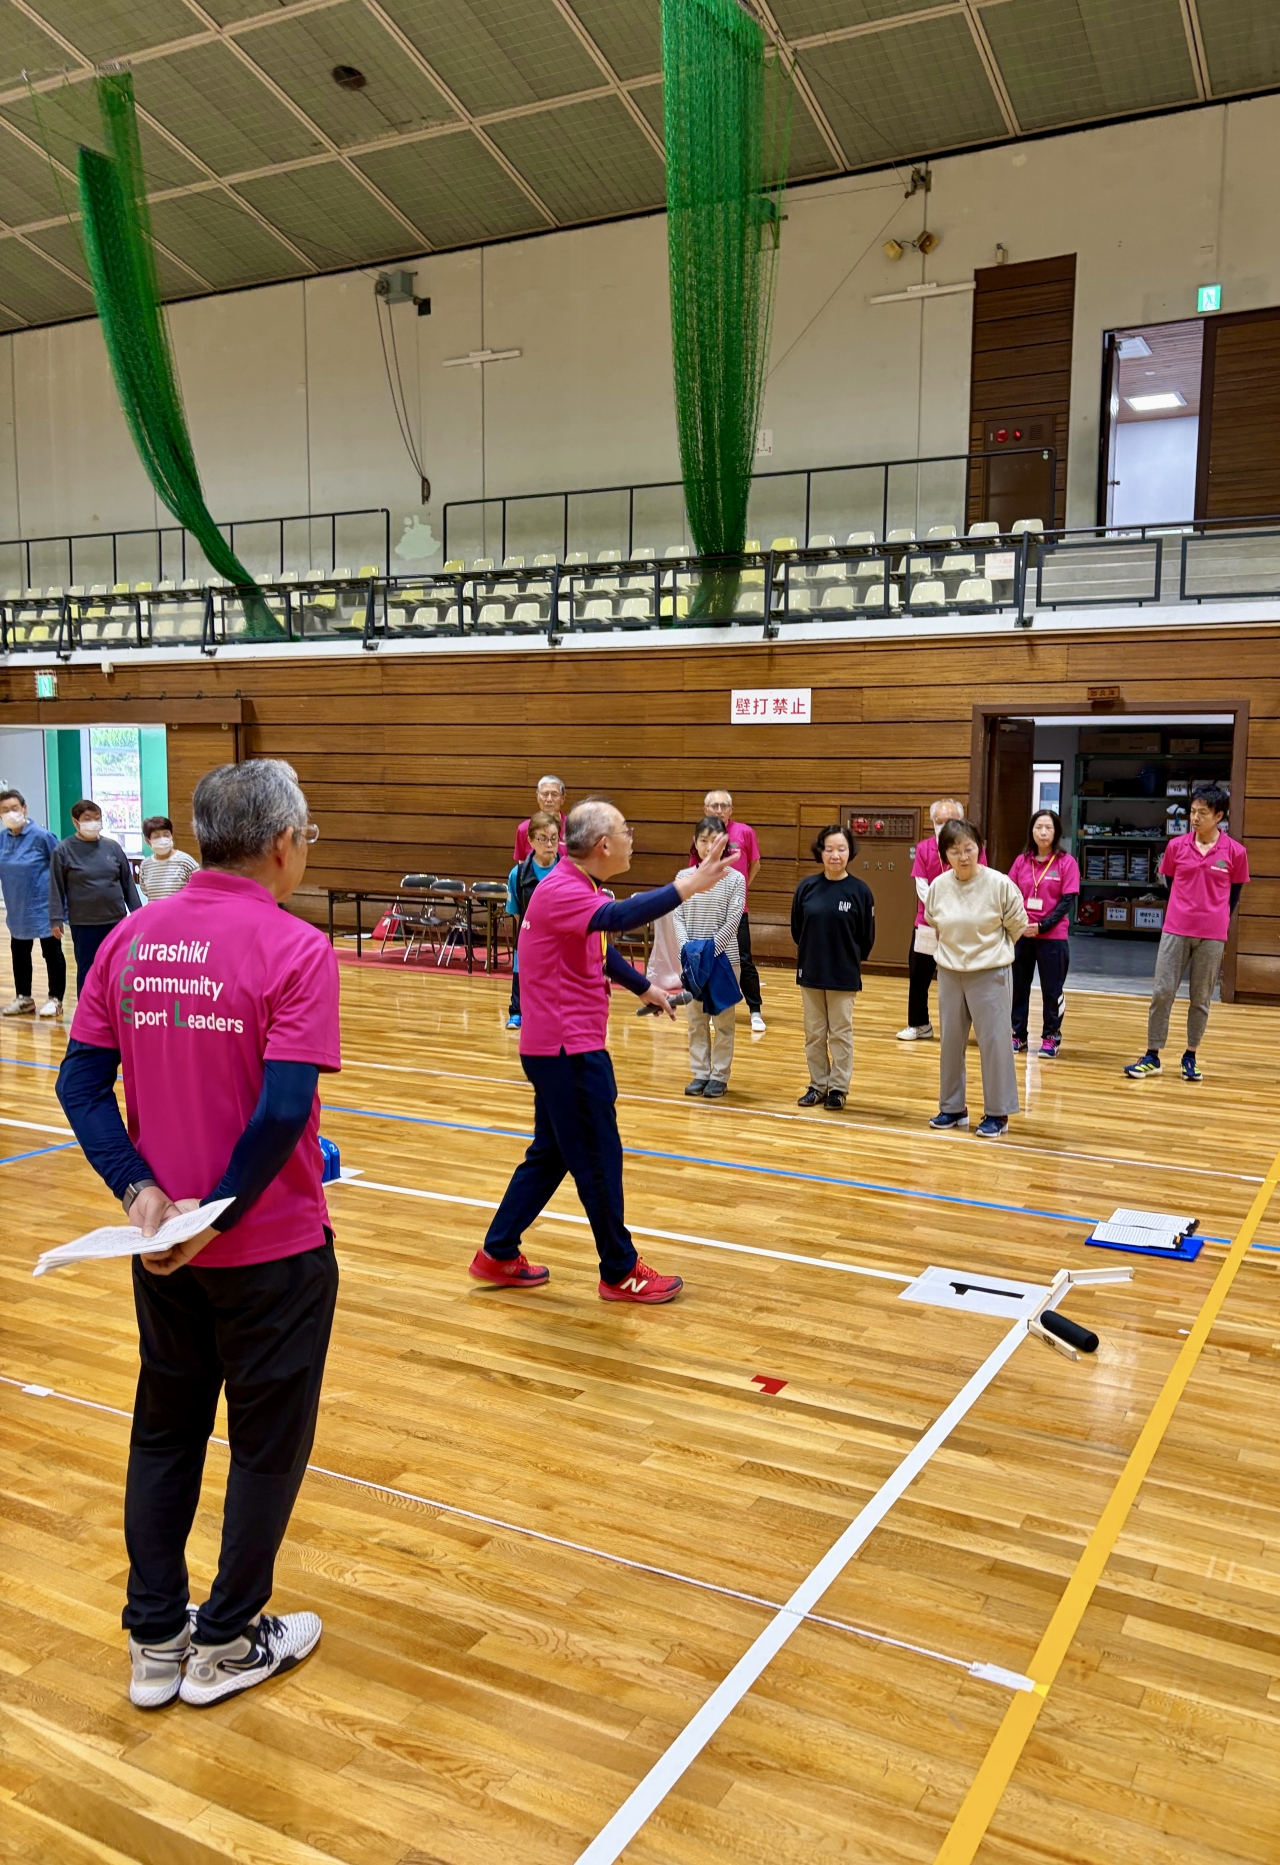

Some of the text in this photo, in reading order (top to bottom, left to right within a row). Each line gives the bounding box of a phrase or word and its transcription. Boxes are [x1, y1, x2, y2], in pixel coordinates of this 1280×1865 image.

[735, 697, 806, 715] 壁打禁止
[126, 932, 210, 963] Kurashiki
[120, 965, 224, 1002] Community
[121, 998, 244, 1034] Sport Leaders
[329, 1143, 338, 1152] 2
[620, 1277, 649, 1293] N
[949, 1281, 1025, 1300] 1
